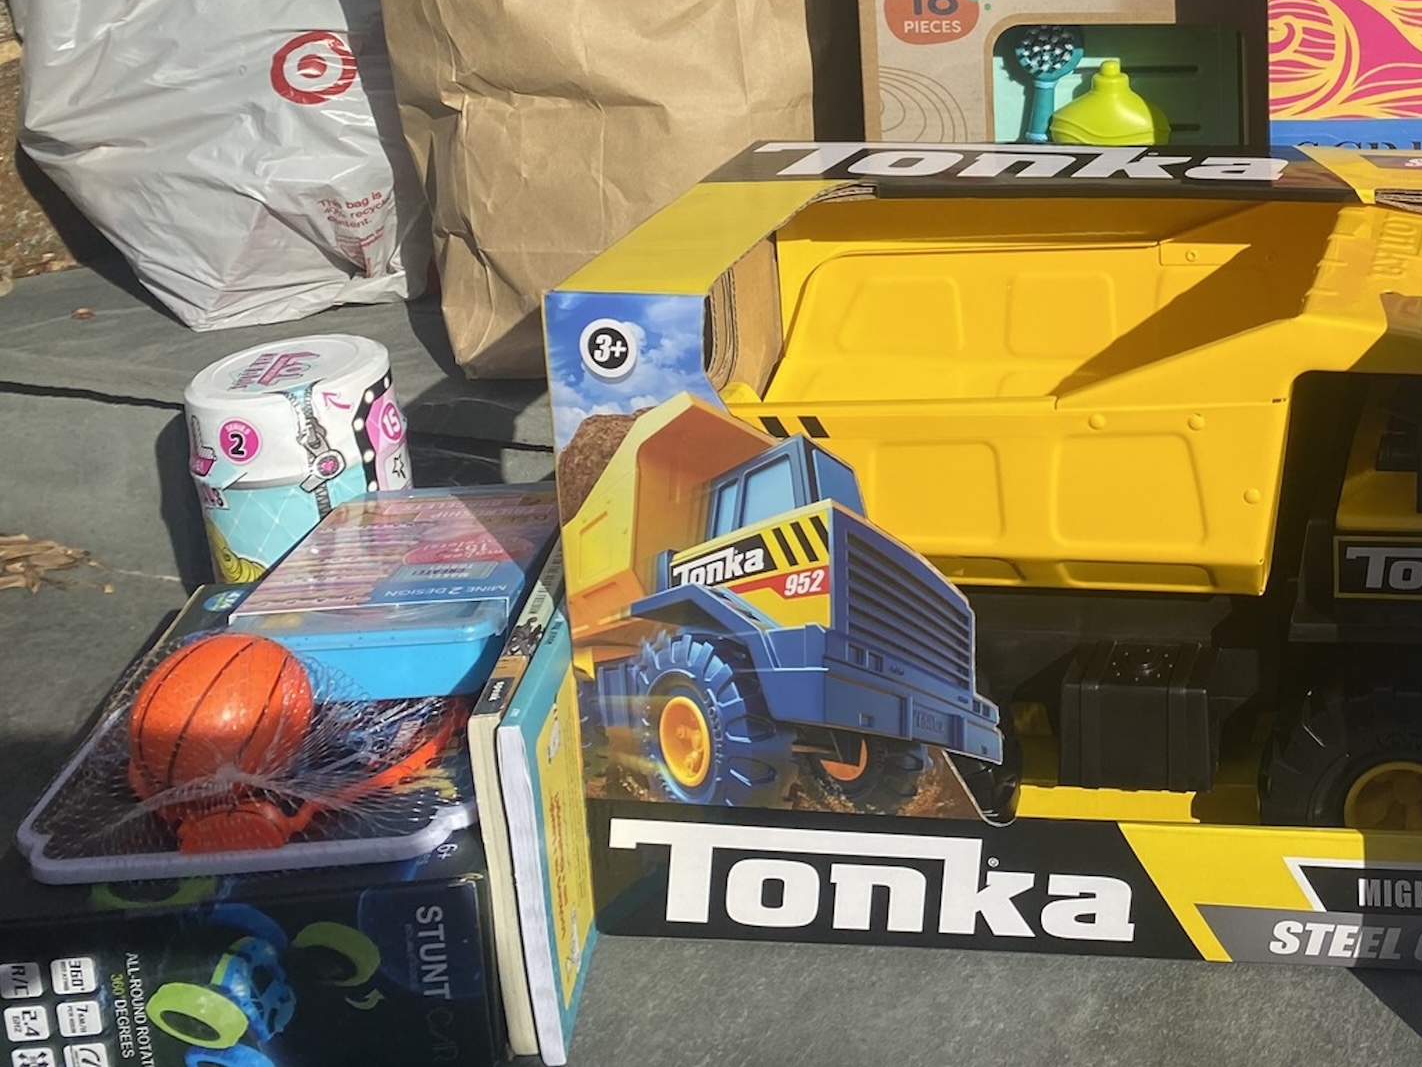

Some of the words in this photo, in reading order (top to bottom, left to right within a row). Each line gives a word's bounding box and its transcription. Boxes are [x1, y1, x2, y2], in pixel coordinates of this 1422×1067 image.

[903, 20, 962, 34] PIECES
[752, 142, 1291, 181] Tonka
[346, 197, 369, 210] bag
[371, 191, 382, 200] is
[593, 334, 627, 363] 3+
[383, 408, 401, 439] 15
[229, 433, 245, 456] 2
[671, 544, 765, 589] Tonka
[384, 587, 448, 597] DESIGN
[448, 586, 463, 595] 2
[467, 584, 507, 593] MINE
[784, 569, 826, 598] 952
[609, 817, 1135, 942] Tonka
[415, 905, 452, 1001] STUNT
[1269, 919, 1407, 961] STEEL
[11, 964, 30, 996] R/C
[125, 952, 148, 1023] ALL-ROUND
[22, 1009, 41, 1037] 2.4
[114, 998, 135, 1060] DEGREES
